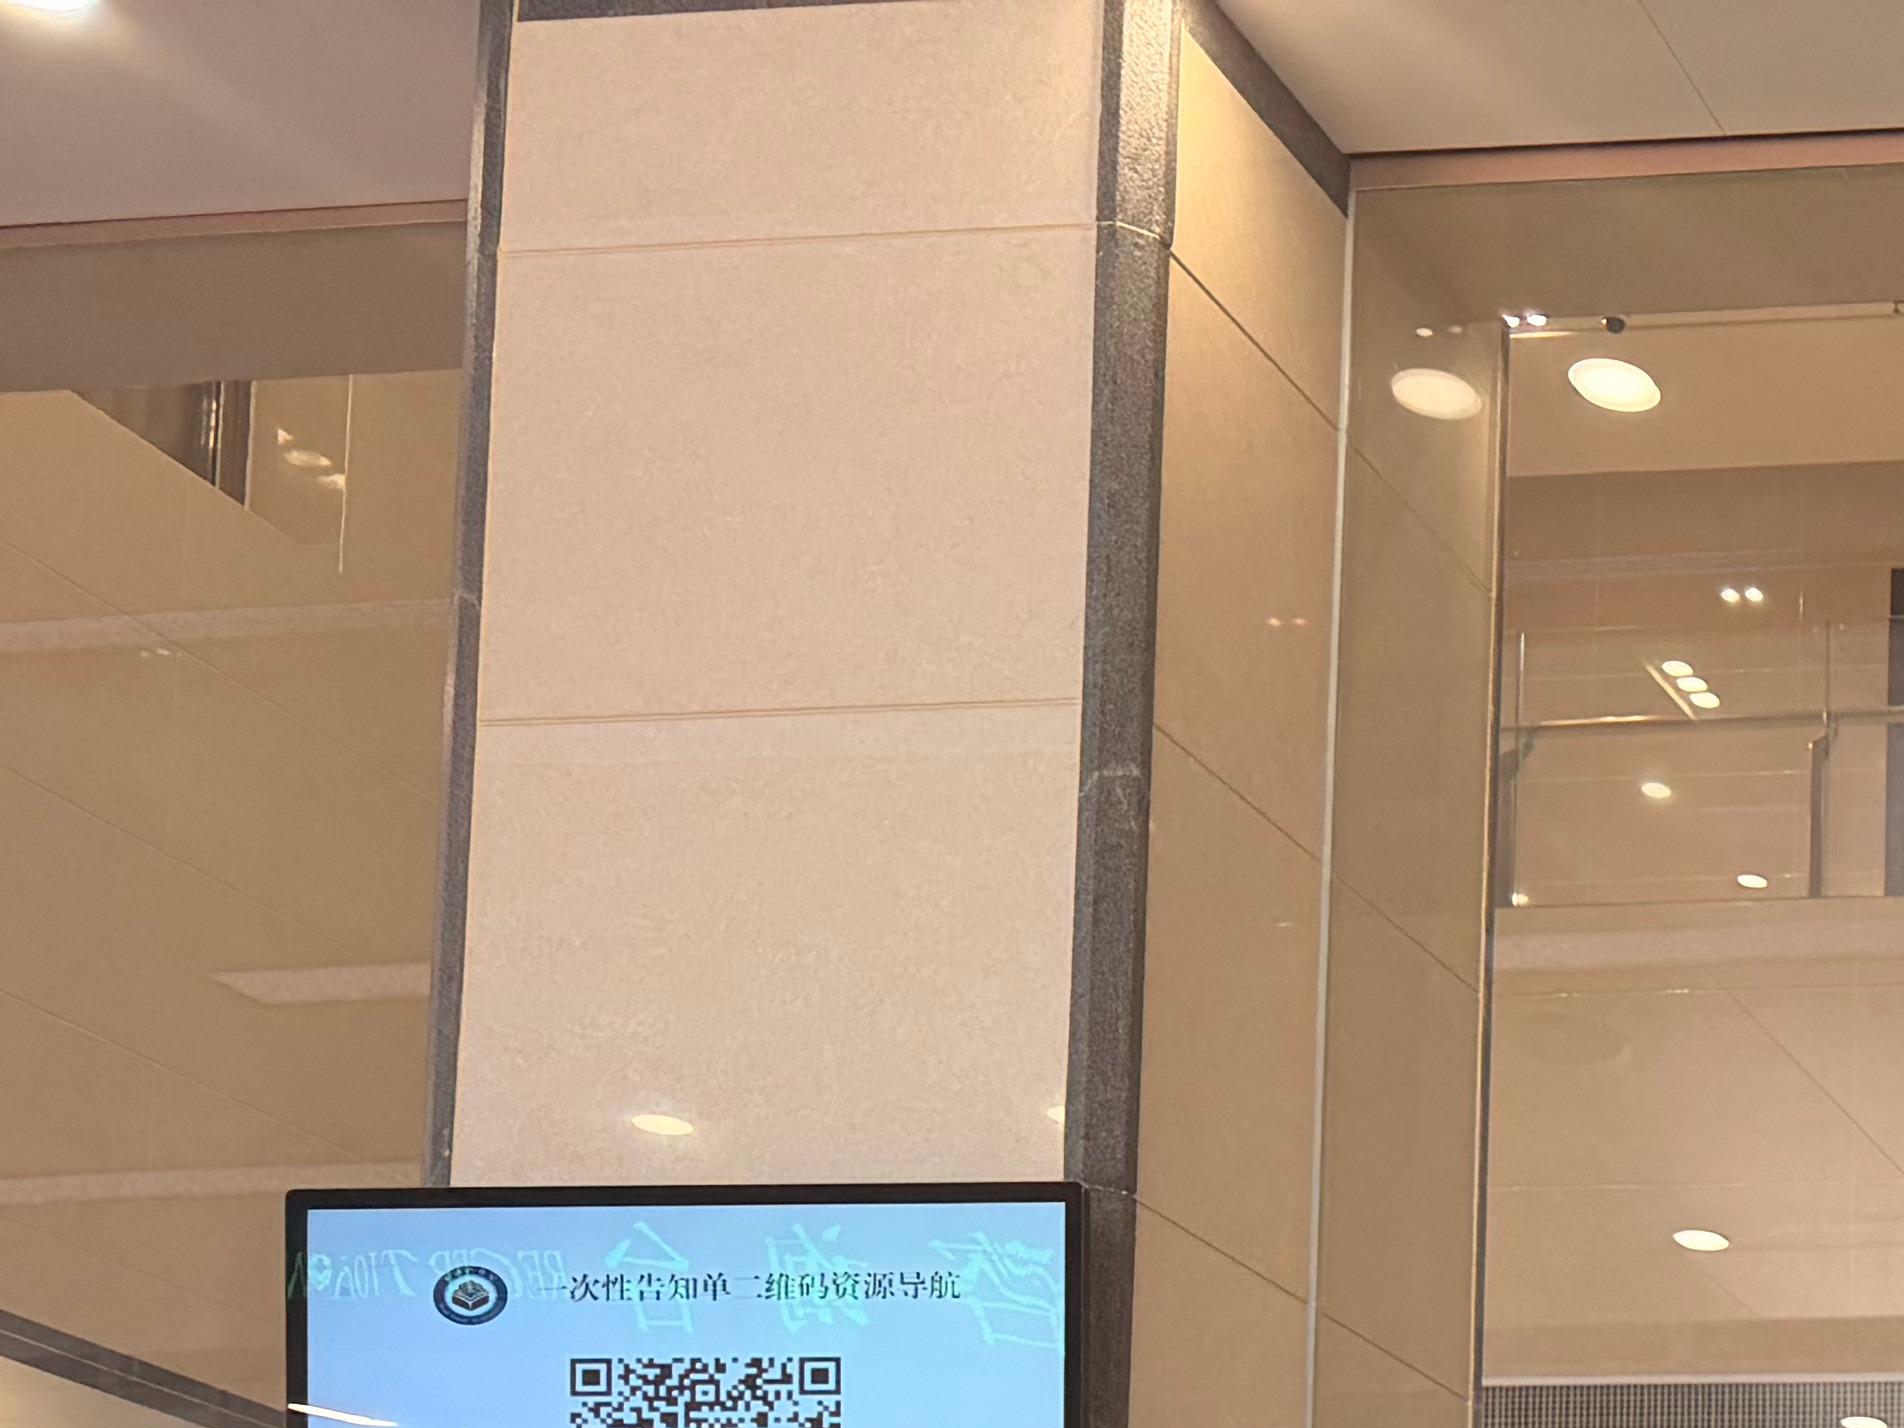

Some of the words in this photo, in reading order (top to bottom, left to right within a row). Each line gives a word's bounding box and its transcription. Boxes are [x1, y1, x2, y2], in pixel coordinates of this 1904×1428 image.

[536, 1269, 962, 1304] 一次性告知单二维码资源导航
